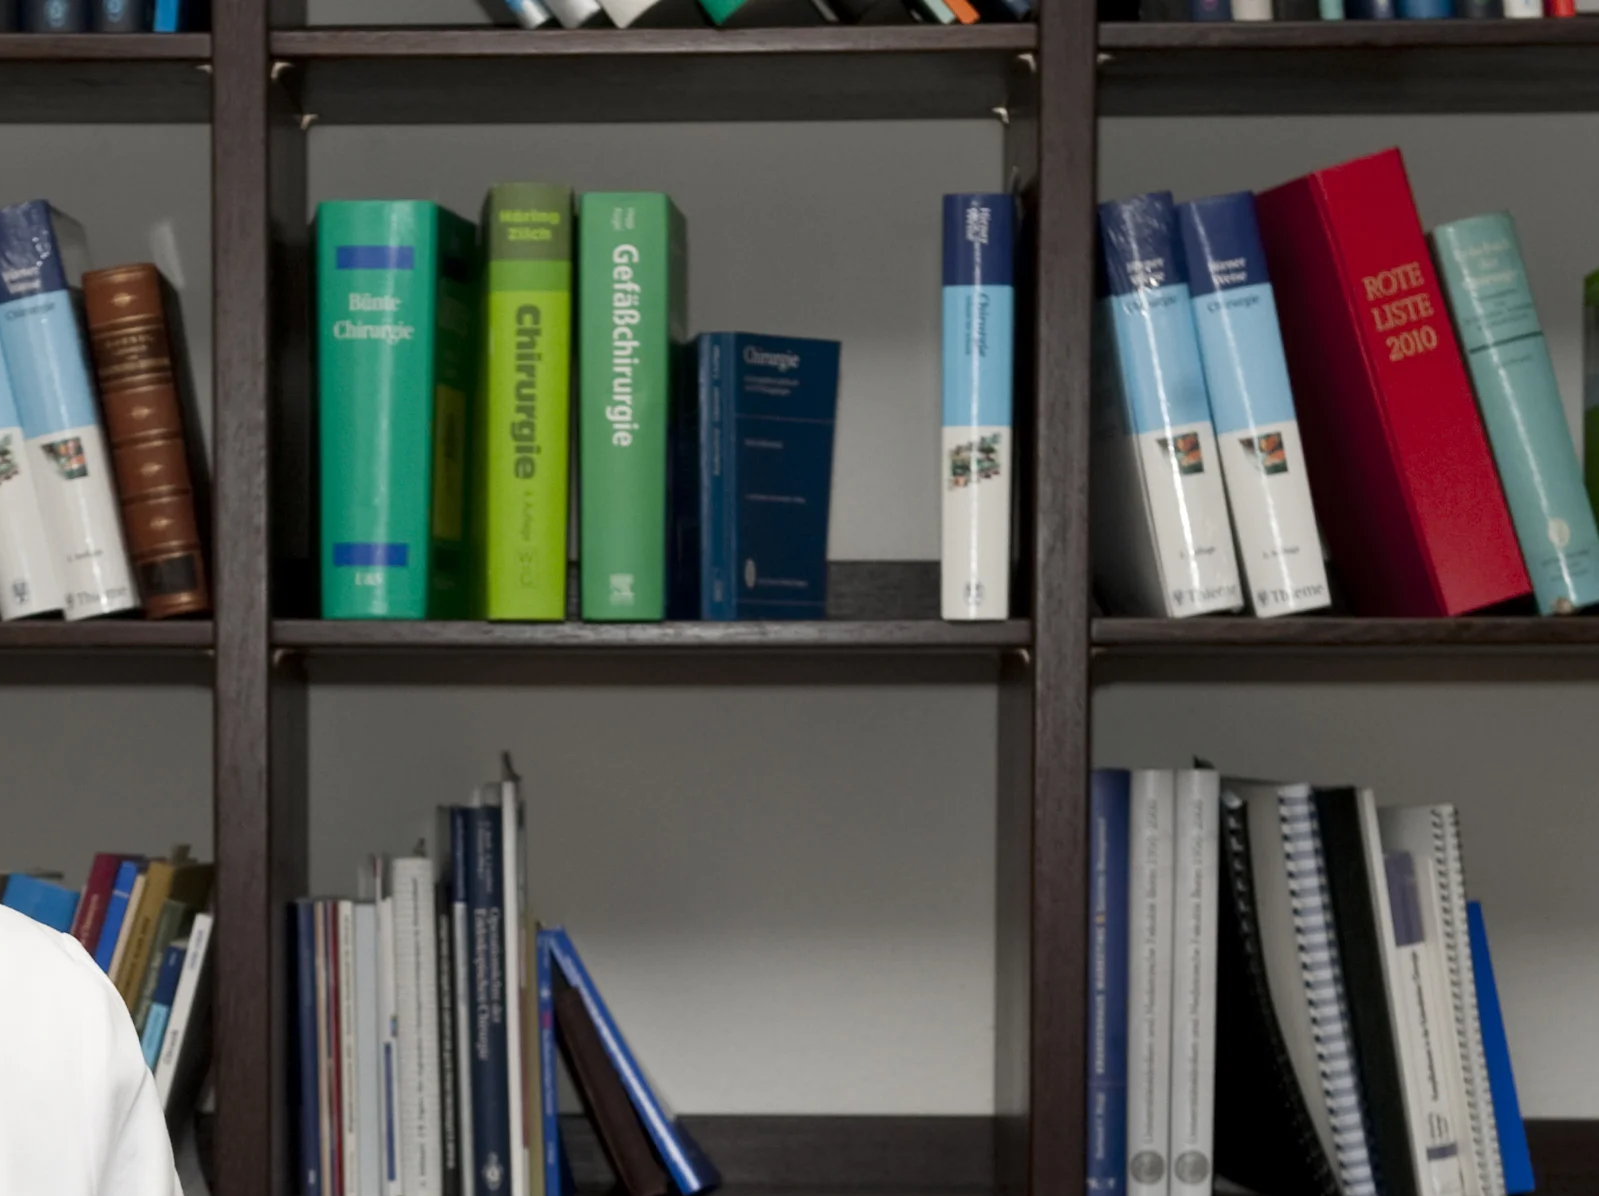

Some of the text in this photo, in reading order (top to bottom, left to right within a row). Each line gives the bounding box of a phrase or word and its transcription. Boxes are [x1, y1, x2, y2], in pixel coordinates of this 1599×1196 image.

[1363, 262, 1424, 303] ROTE
[348, 292, 401, 312] Bünte
[1371, 295, 1434, 333] LISTE
[332, 320, 415, 345] Chirurgie
[606, 243, 641, 449] Gefäßchirurgie
[1386, 328, 1439, 363] 2010
[742, 345, 801, 373] Chirurgie
[513, 303, 542, 480] Chirurgie
[1270, 582, 1325, 604] Theme
